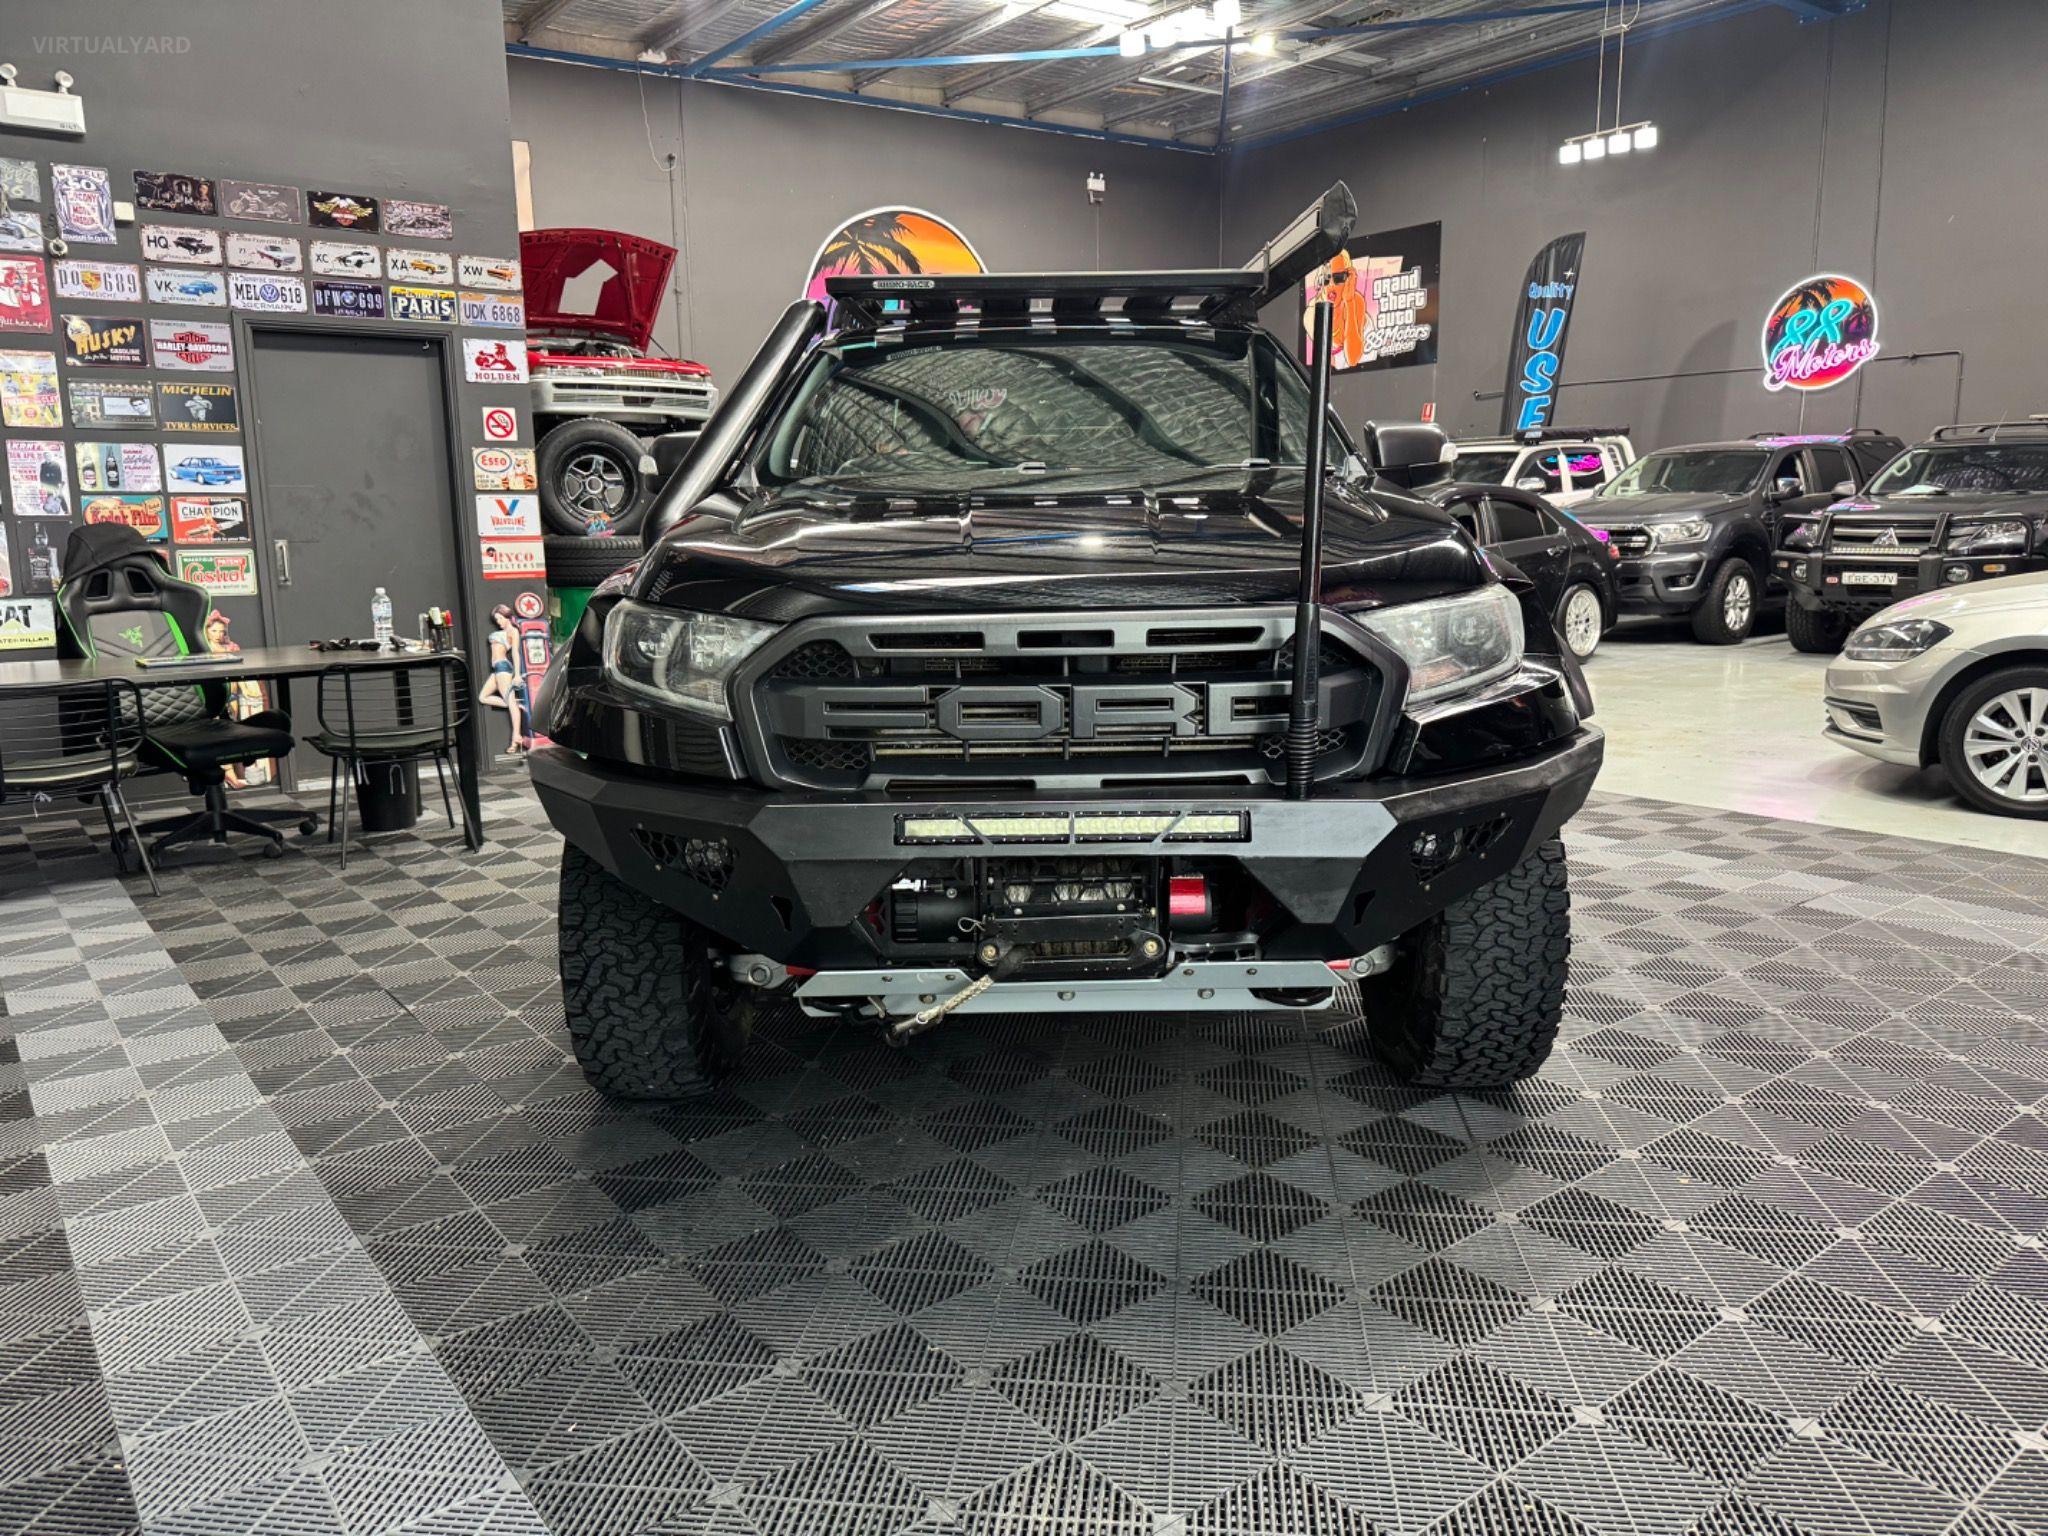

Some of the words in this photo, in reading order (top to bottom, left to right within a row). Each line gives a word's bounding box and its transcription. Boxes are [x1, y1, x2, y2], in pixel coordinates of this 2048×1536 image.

[147, 235, 169, 248] HQ
[316, 254, 329, 263] XC
[391, 259, 409, 271] XA
[463, 265, 483, 276] XW
[103, 272, 137, 293] 689
[154, 280, 173, 292] VK
[1374, 266, 1421, 299] grand
[1528, 282, 1574, 299] Quality
[234, 283, 260, 301] MEL
[280, 286, 303, 304] 618
[1379, 290, 1427, 313] theft
[397, 296, 451, 317] PARIS
[464, 303, 487, 320] UDK
[491, 305, 520, 323] 6868
[1377, 308, 1415, 328] auto
[76, 325, 137, 356] HUSKY
[1769, 299, 1854, 364] 88
[156, 341, 228, 354] HARLEY-DAVIDSON
[1766, 338, 1877, 386] Motors
[475, 372, 520, 381] HOLDEN
[161, 386, 232, 396] MICHELIN
[184, 557, 246, 583] Castrol
[793, 682, 1308, 740] FORD
